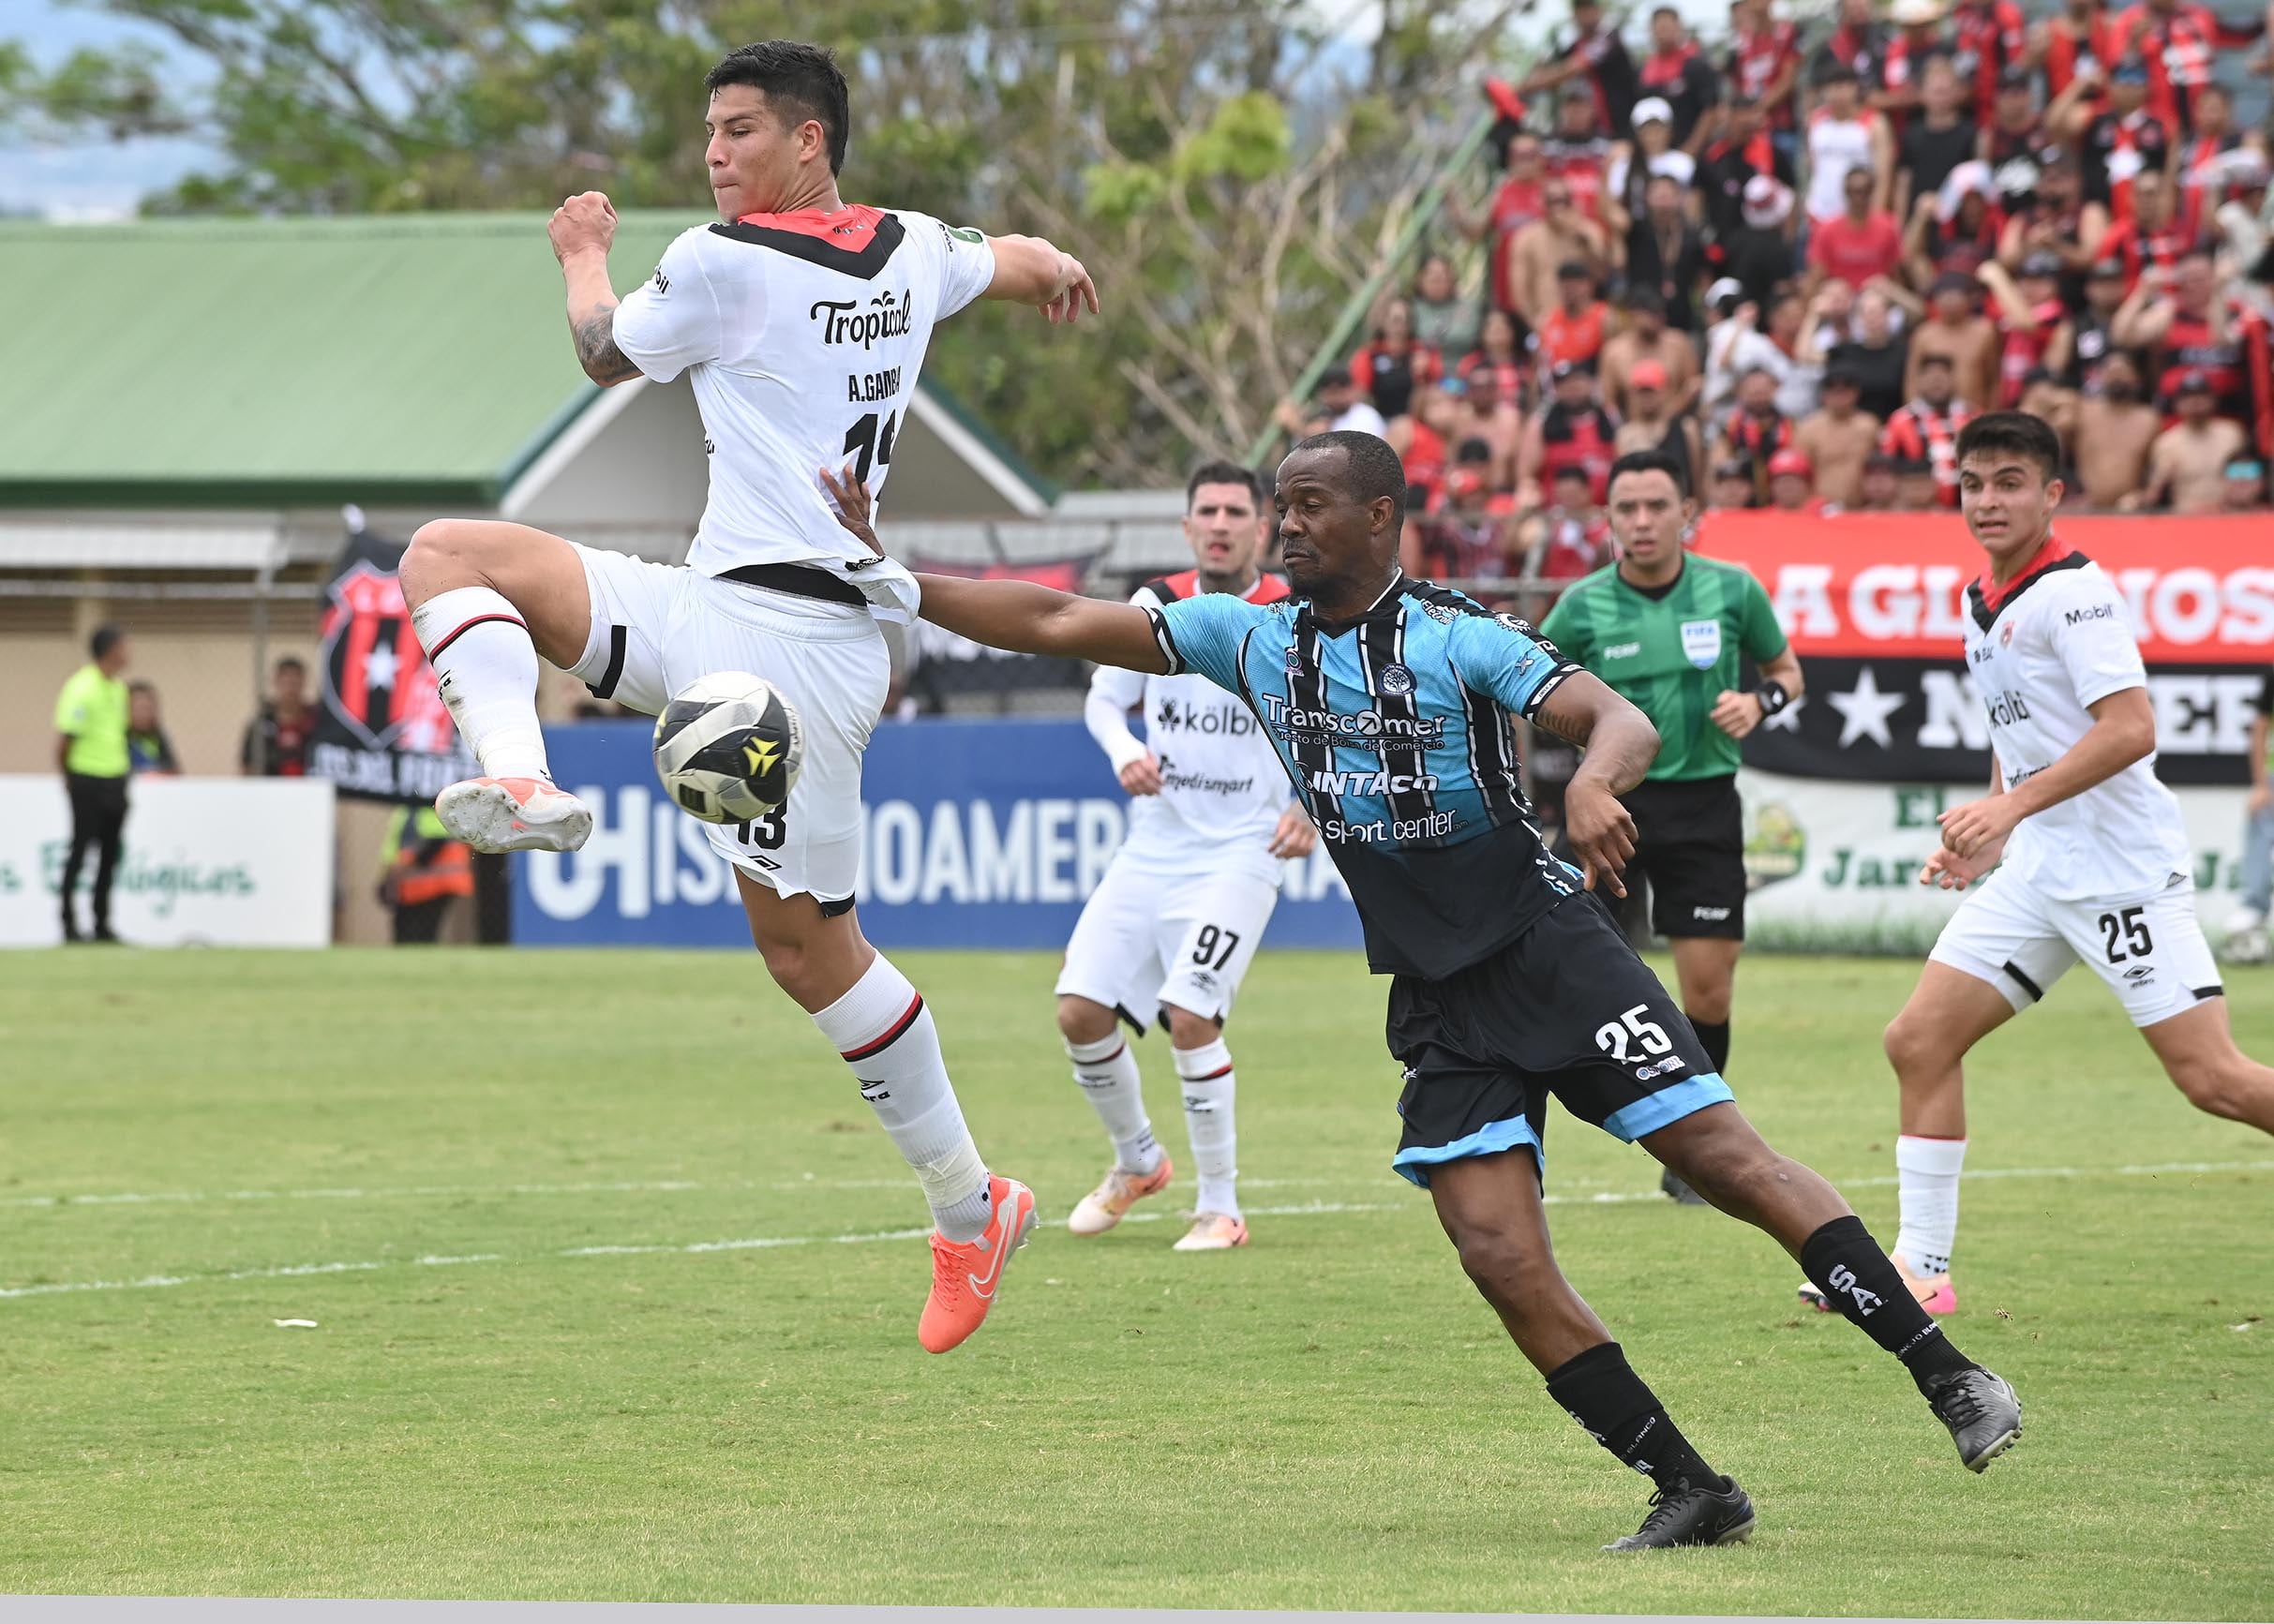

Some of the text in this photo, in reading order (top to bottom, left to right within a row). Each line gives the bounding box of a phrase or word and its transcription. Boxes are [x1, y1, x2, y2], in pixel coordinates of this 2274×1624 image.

[810, 288, 911, 350] Tropical
[2065, 604, 2114, 626] Mobil
[1263, 693, 1446, 737] Transcomer
[1313, 734, 1329, 746] de
[1364, 739, 1380, 752] de
[1393, 808, 1457, 841] center
[1192, 924, 1240, 972] 97
[2098, 905, 2154, 964] 25
[1594, 1003, 1673, 1065] 25
